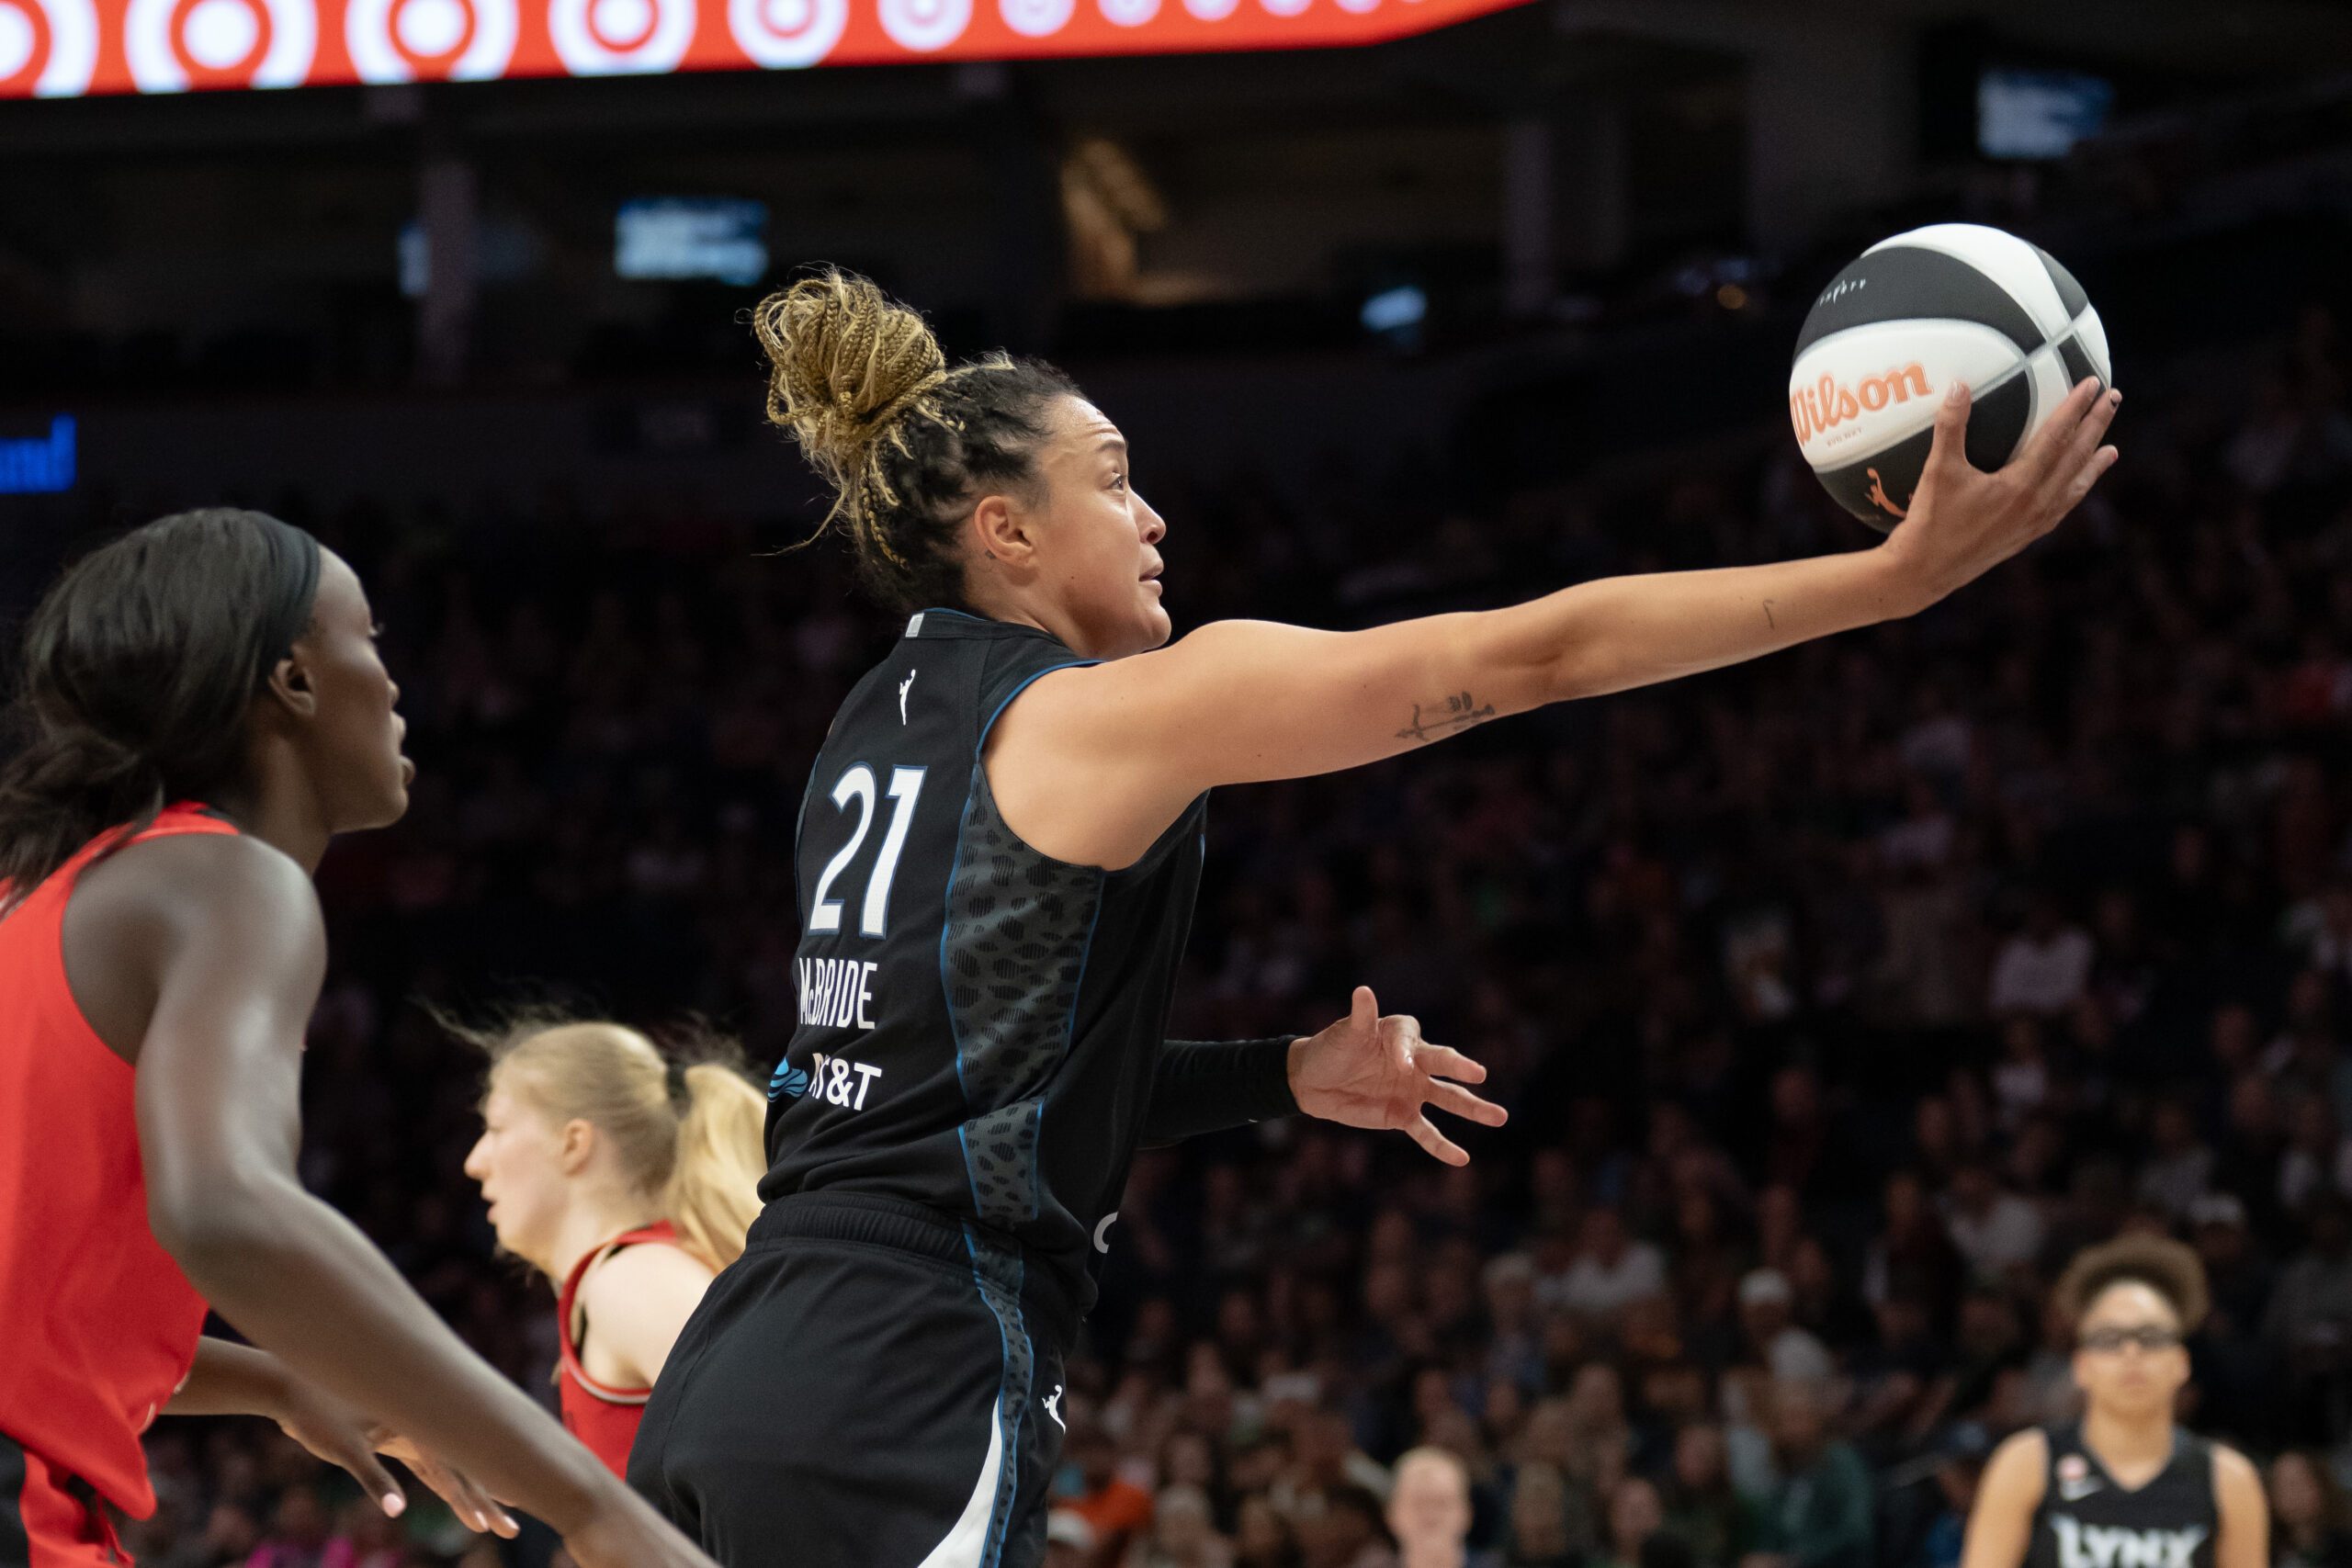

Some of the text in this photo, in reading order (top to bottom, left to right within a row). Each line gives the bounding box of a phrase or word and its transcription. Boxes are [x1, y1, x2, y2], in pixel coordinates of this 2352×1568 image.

[1791, 363, 1935, 449] Wilson
[808, 762, 927, 940] 21
[798, 957, 877, 1029] McBRIDE
